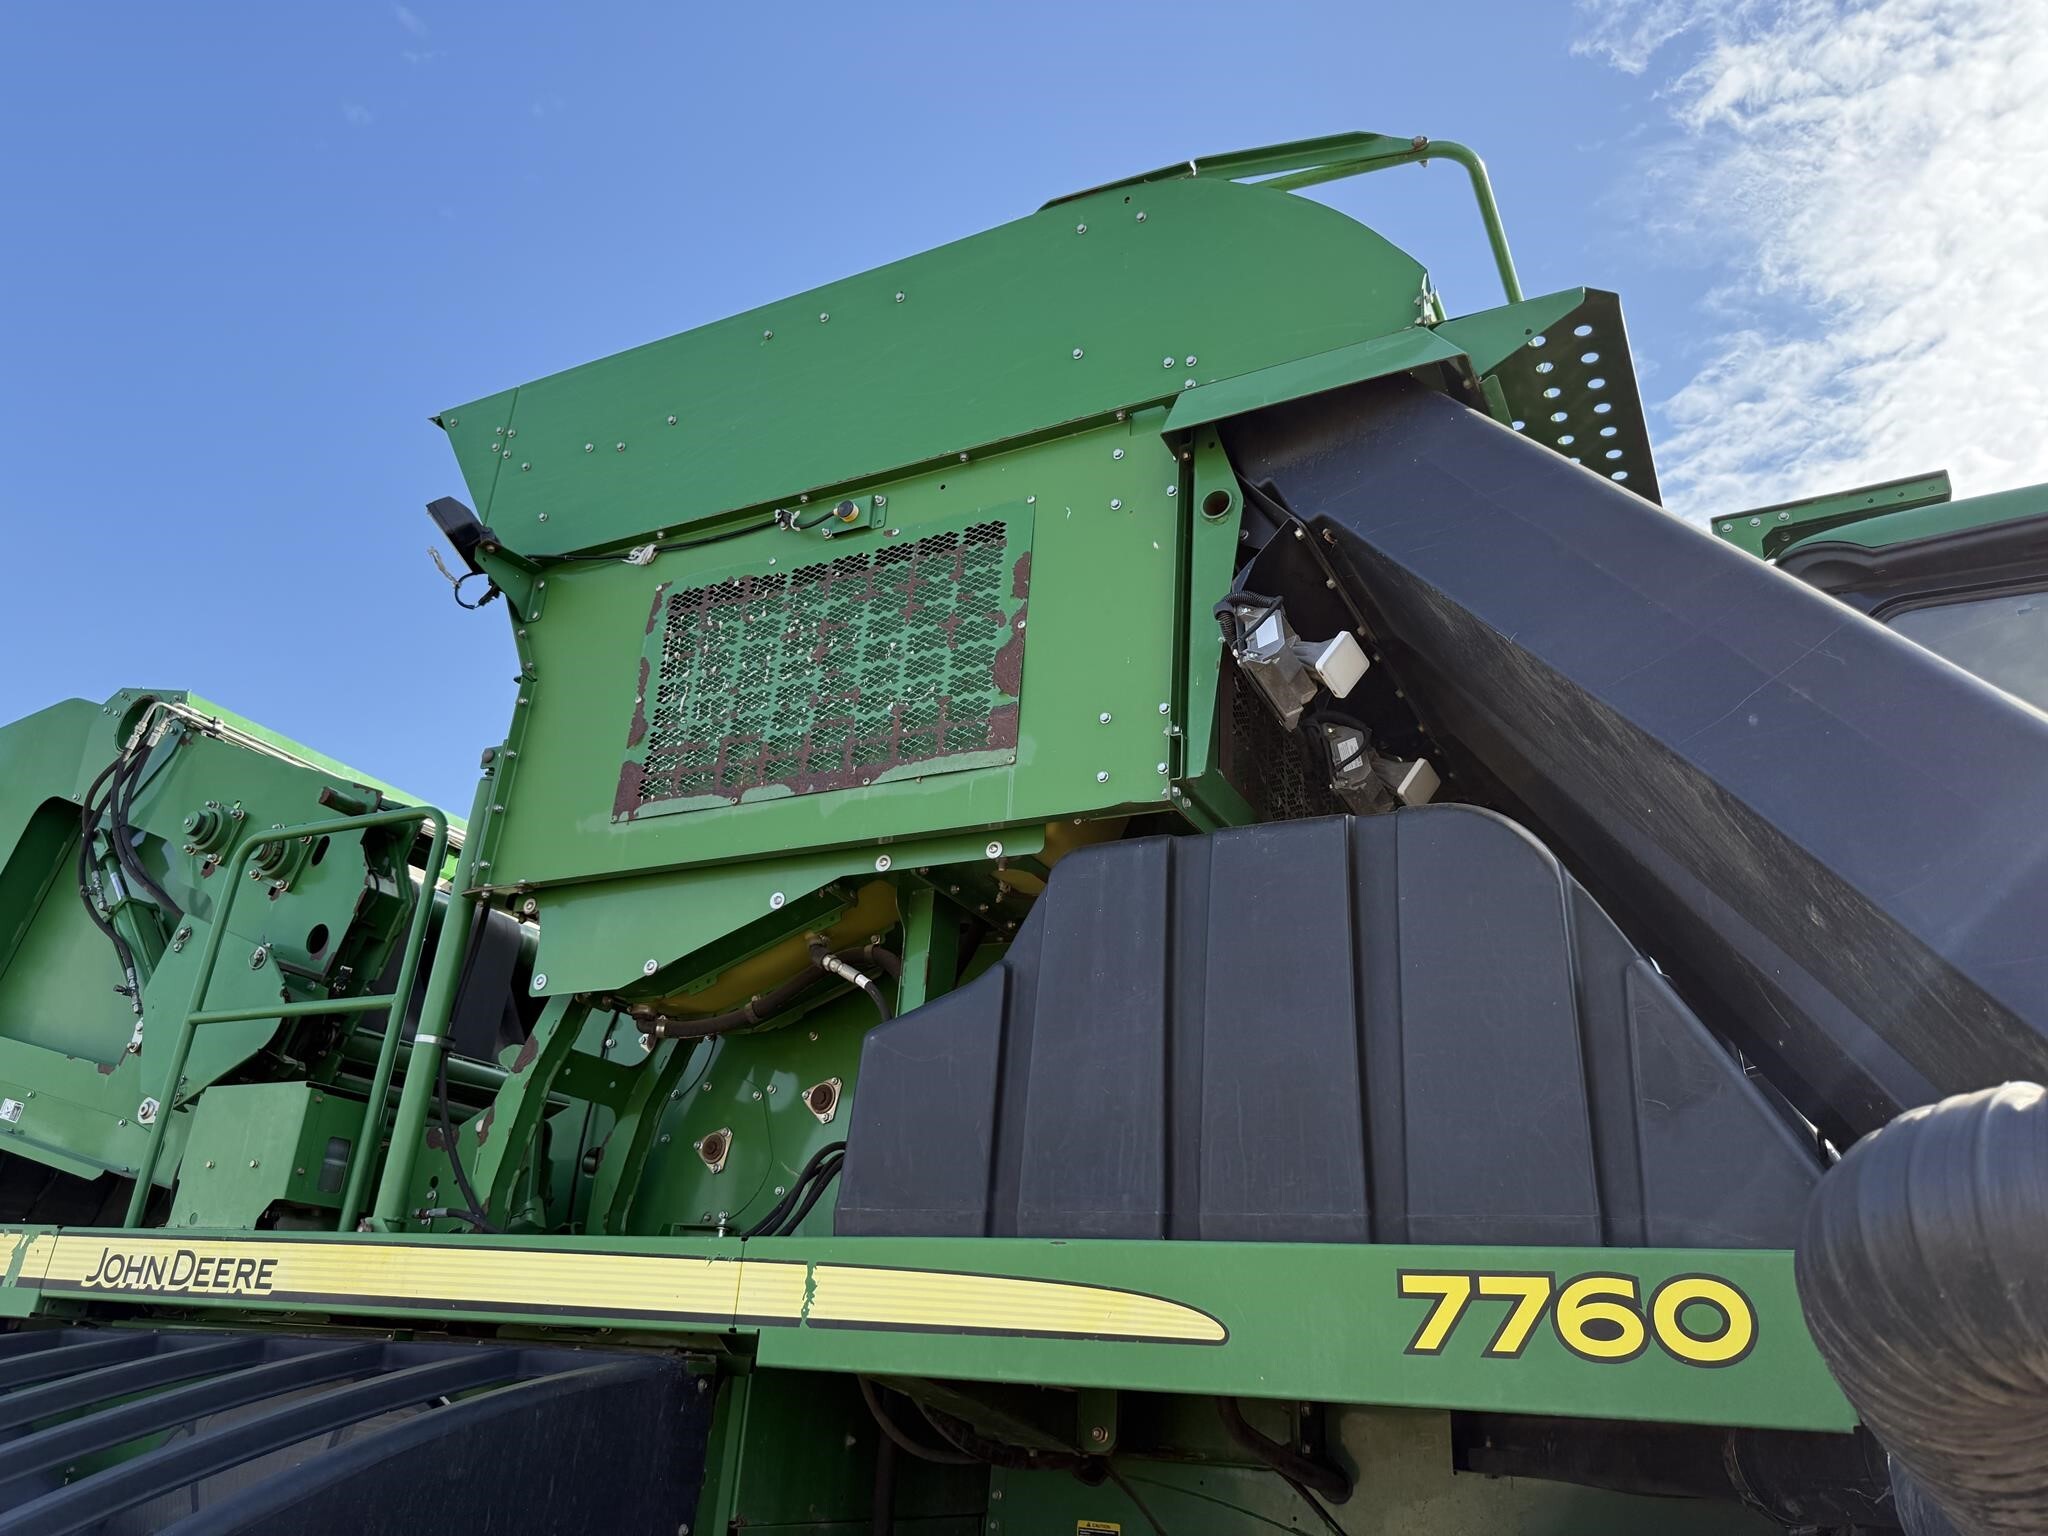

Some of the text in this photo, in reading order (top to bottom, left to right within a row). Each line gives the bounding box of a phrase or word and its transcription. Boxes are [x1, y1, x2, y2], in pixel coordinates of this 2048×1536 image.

[85, 1247, 279, 1289] JOHN DEERE
[1397, 1268, 1759, 1369] 7760
